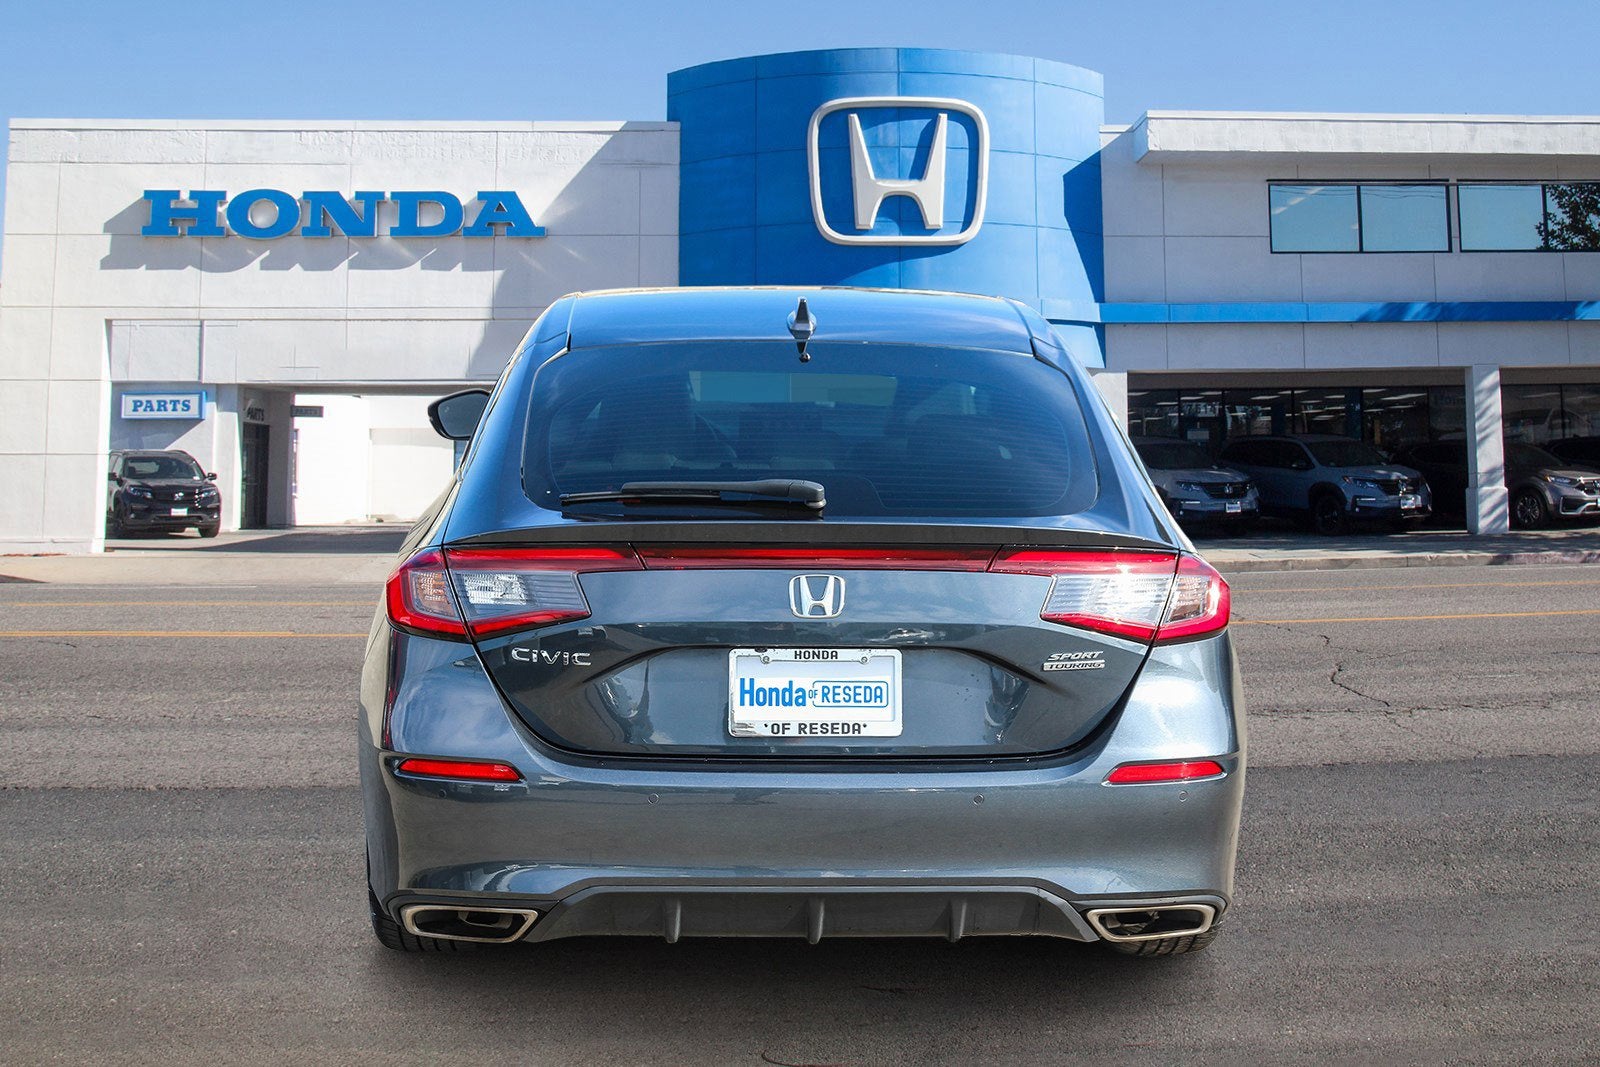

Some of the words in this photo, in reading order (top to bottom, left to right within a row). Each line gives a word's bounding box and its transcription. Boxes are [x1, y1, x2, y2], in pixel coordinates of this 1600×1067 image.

[141, 189, 547, 239] HONDA
[132, 399, 192, 413] PARTS
[511, 647, 592, 666] CIVIC
[794, 650, 839, 660] HONDA
[1047, 650, 1104, 661] SPORT
[1049, 662, 1102, 670] TOURING
[739, 678, 806, 707] Honda
[808, 689, 818, 699] OF
[821, 685, 883, 704] RESEDA
[770, 723, 791, 735] OF
[797, 723, 862, 735] RESEDA
